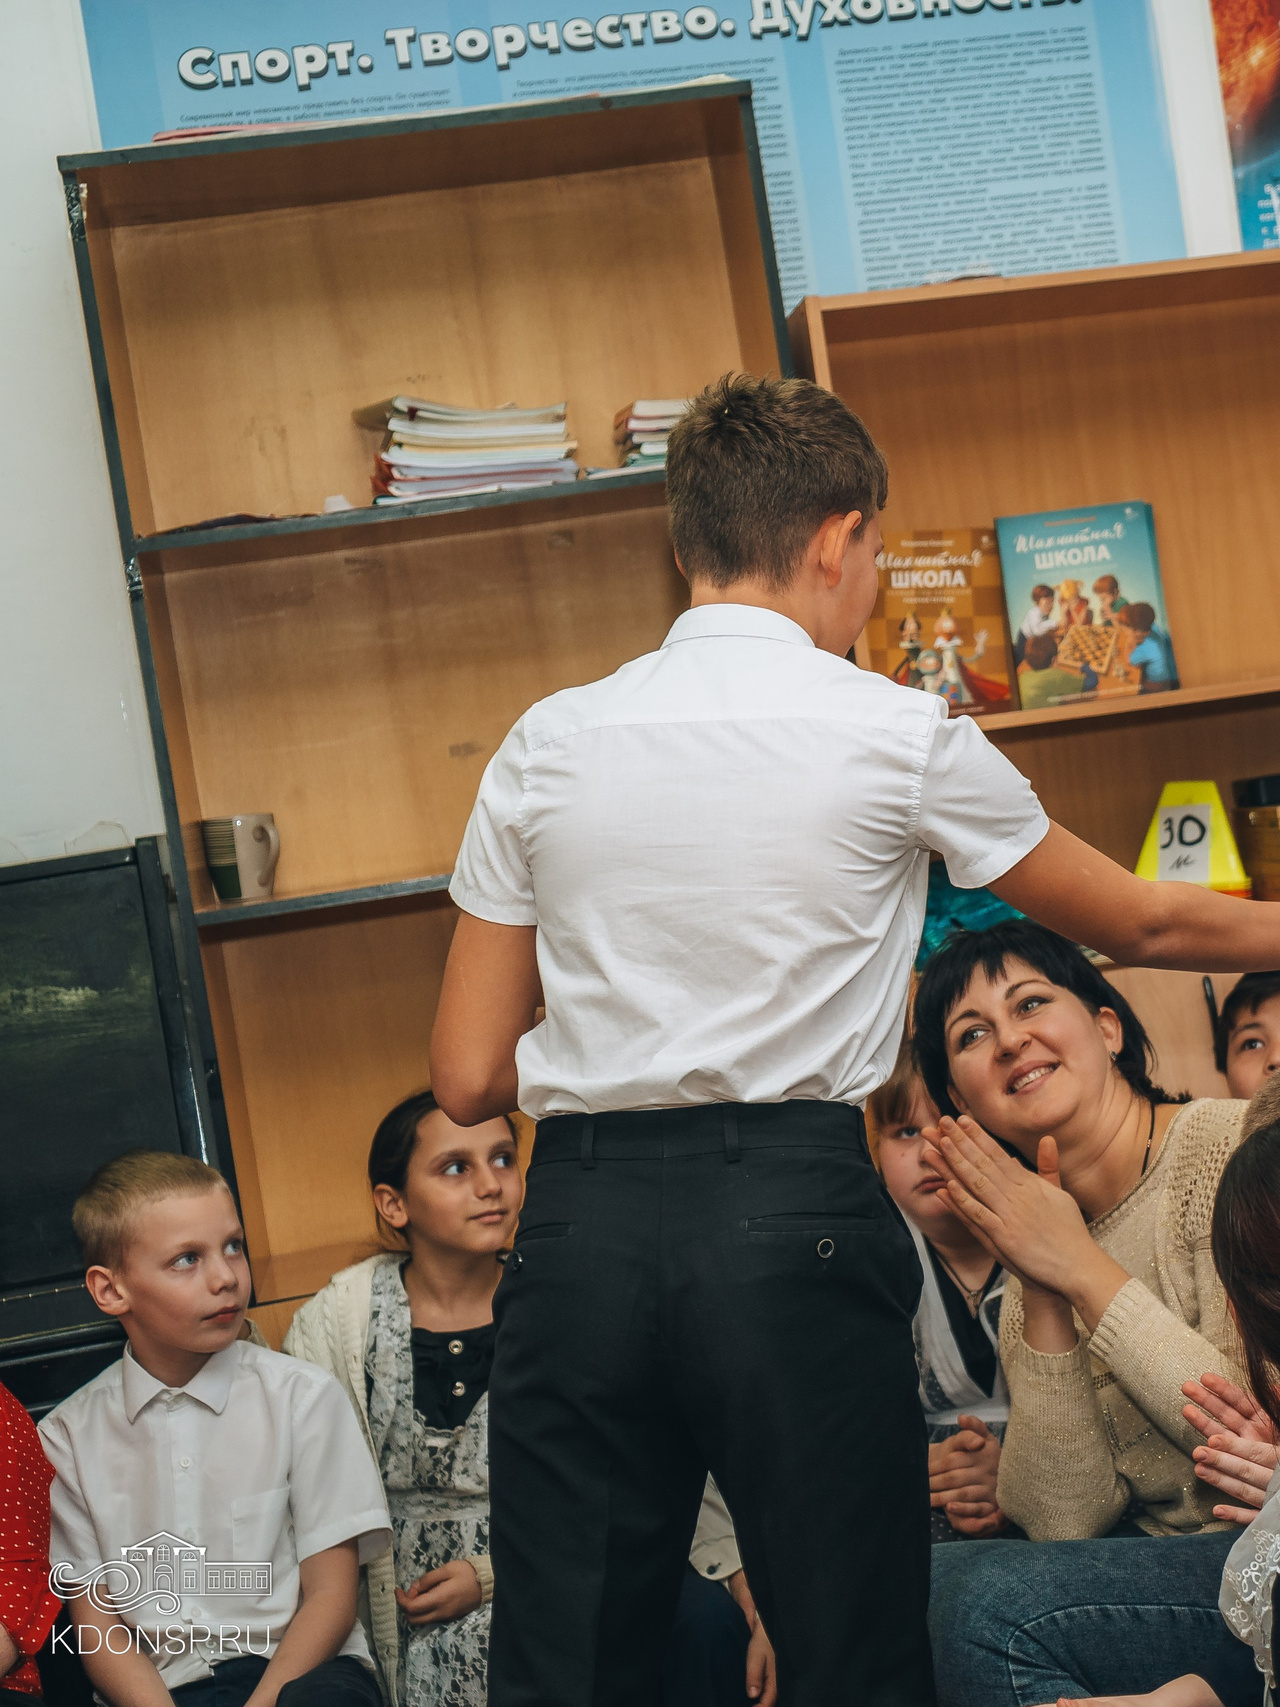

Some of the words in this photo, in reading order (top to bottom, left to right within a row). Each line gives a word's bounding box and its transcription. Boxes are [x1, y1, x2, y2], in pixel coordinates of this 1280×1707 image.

[178, 41, 373, 92] Спорт.
[384, 5, 736, 71] Творчество.
[749, 0, 1082, 41] Духовн
[1013, 521, 1124, 553] Шахматная
[875, 549, 982, 570] Шахматная
[1034, 544, 1111, 570] ШКОЛА
[890, 569, 968, 589] ШКОЛА
